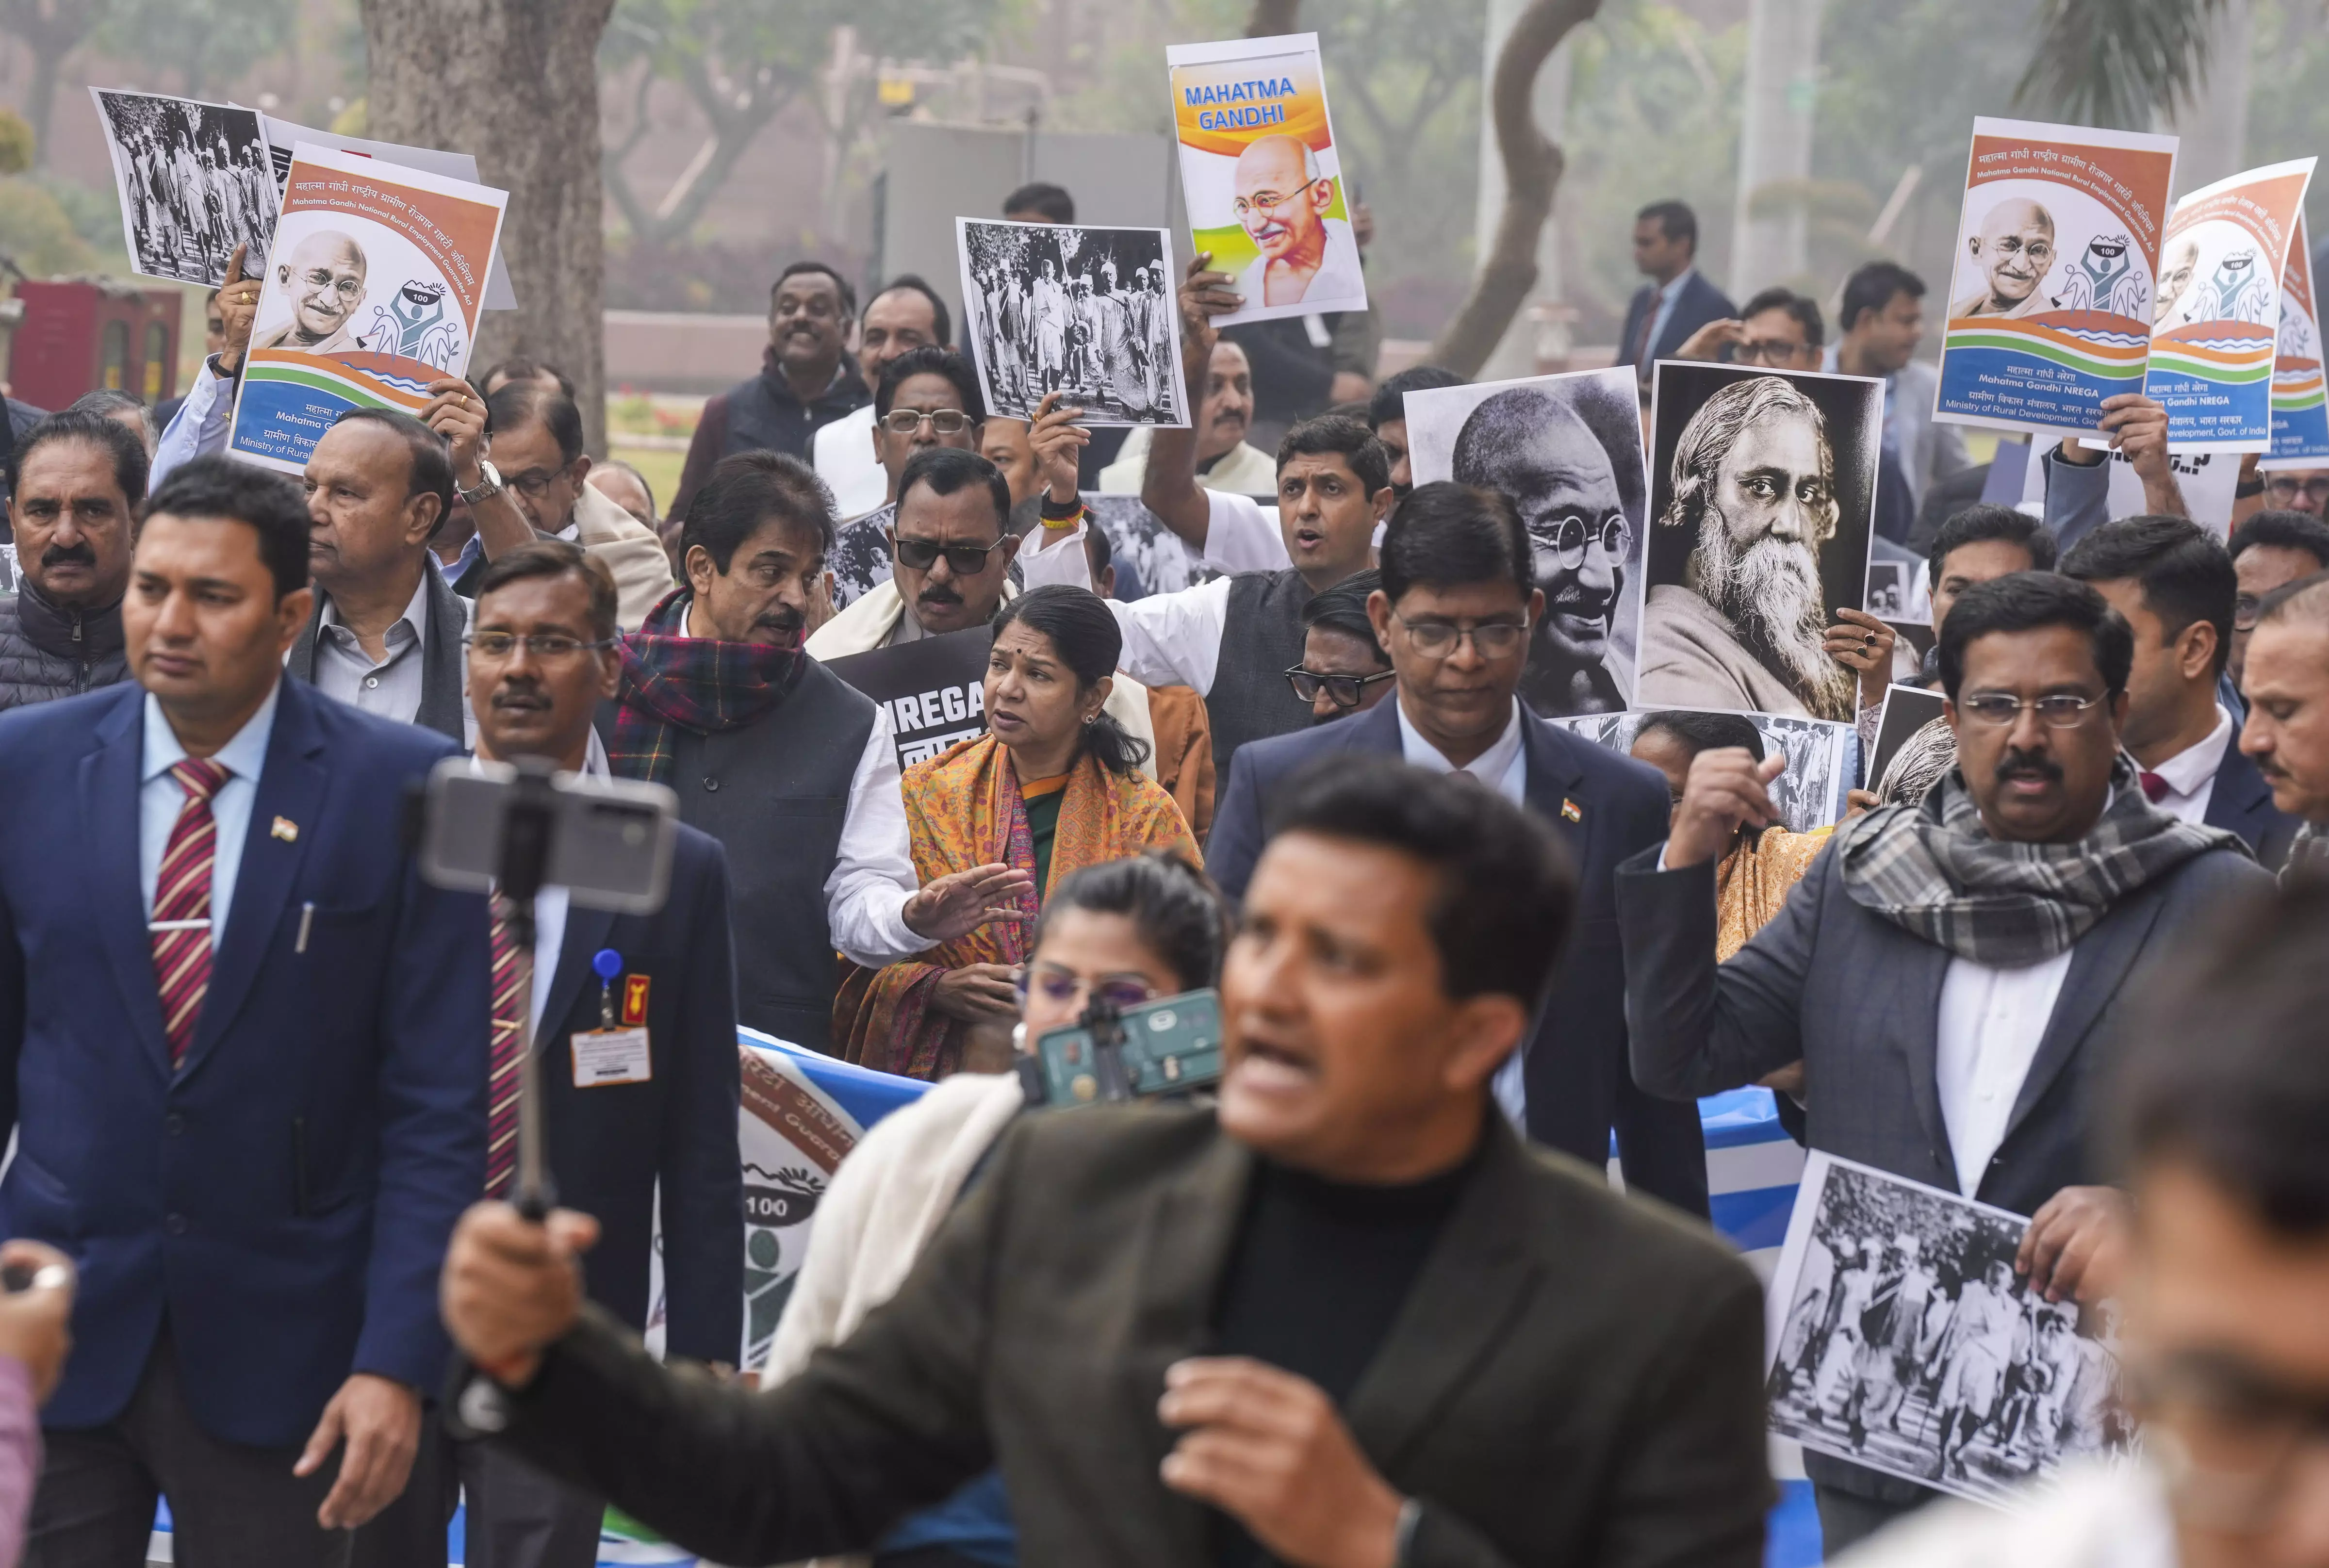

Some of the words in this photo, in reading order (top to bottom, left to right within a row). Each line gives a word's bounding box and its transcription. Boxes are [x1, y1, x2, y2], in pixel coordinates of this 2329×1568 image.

[1185, 77, 1297, 106] MAHATMA
[1199, 103, 1285, 131] GANDHI
[1978, 151, 2007, 164] महात्मा
[2010, 147, 2030, 160] गांधी
[2033, 149, 2058, 162] राष्ट्रीय
[2061, 154, 2086, 169] ग्रामीण
[2088, 162, 2114, 186] रोजगार
[2131, 200, 2155, 233] अधिनियम
[1977, 168, 2011, 179] Mahatma
[2041, 167, 2071, 179] National
[2072, 174, 2090, 187] Rural
[2090, 182, 2126, 212] Employment
[2125, 210, 2148, 242] Guarantee
[2146, 242, 2155, 253] Act
[295, 182, 325, 192] महात्मा
[328, 180, 348, 192] गांधी
[352, 185, 378, 199] राष्ट्रीय
[380, 193, 407, 211] ग्रामीण
[408, 204, 434, 231] रोजगार
[434, 228, 453, 249] गारंटी
[451, 250, 475, 286] अधिनियम
[329, 199, 357, 208] Gandhi
[358, 203, 389, 219] National
[390, 214, 409, 229] Rural
[408, 226, 444, 260] Employment
[443, 259, 466, 294] Guarantee
[463, 294, 473, 306] Act
[2100, 247, 2115, 256] 100
[413, 294, 428, 302] 100
[2006, 364, 2033, 377] महात्मा
[2036, 368, 2054, 379] गांधी
[2057, 369, 2076, 382] नरेगा
[1979, 374, 2024, 388] Mahatma
[2026, 380, 2061, 393] Gandhi
[2064, 385, 2099, 398] NREGA
[305, 404, 333, 417] महात्मा
[1946, 399, 1980, 412] Ministry
[1993, 405, 2017, 416] Rural
[2018, 408, 2079, 425] Development,
[2082, 417, 2102, 425] Gov
[1968, 390, 1995, 402] ग्रामीण
[1998, 392, 2024, 406] विकास
[2027, 397, 2058, 412] मंत्रालय,
[2062, 404, 2082, 414] भारत
[2085, 407, 2108, 417] सरका
[2167, 396, 2198, 407] Gandhi
[2199, 396, 2230, 406] NREGA
[276, 411, 321, 429] Mahatma
[2199, 416, 2217, 425] भारत
[2219, 415, 2243, 425] सरकार
[263, 429, 291, 443] ग्रामीण
[2167, 428, 2216, 439] evelopment,
[2217, 427, 2237, 437] Govt.
[2240, 427, 2247, 436] of
[2249, 426, 2266, 435] India
[240, 436, 274, 453] Ministry
[276, 445, 285, 455] of
[287, 446, 311, 459] Rural
[746, 1196, 787, 1216] 100
